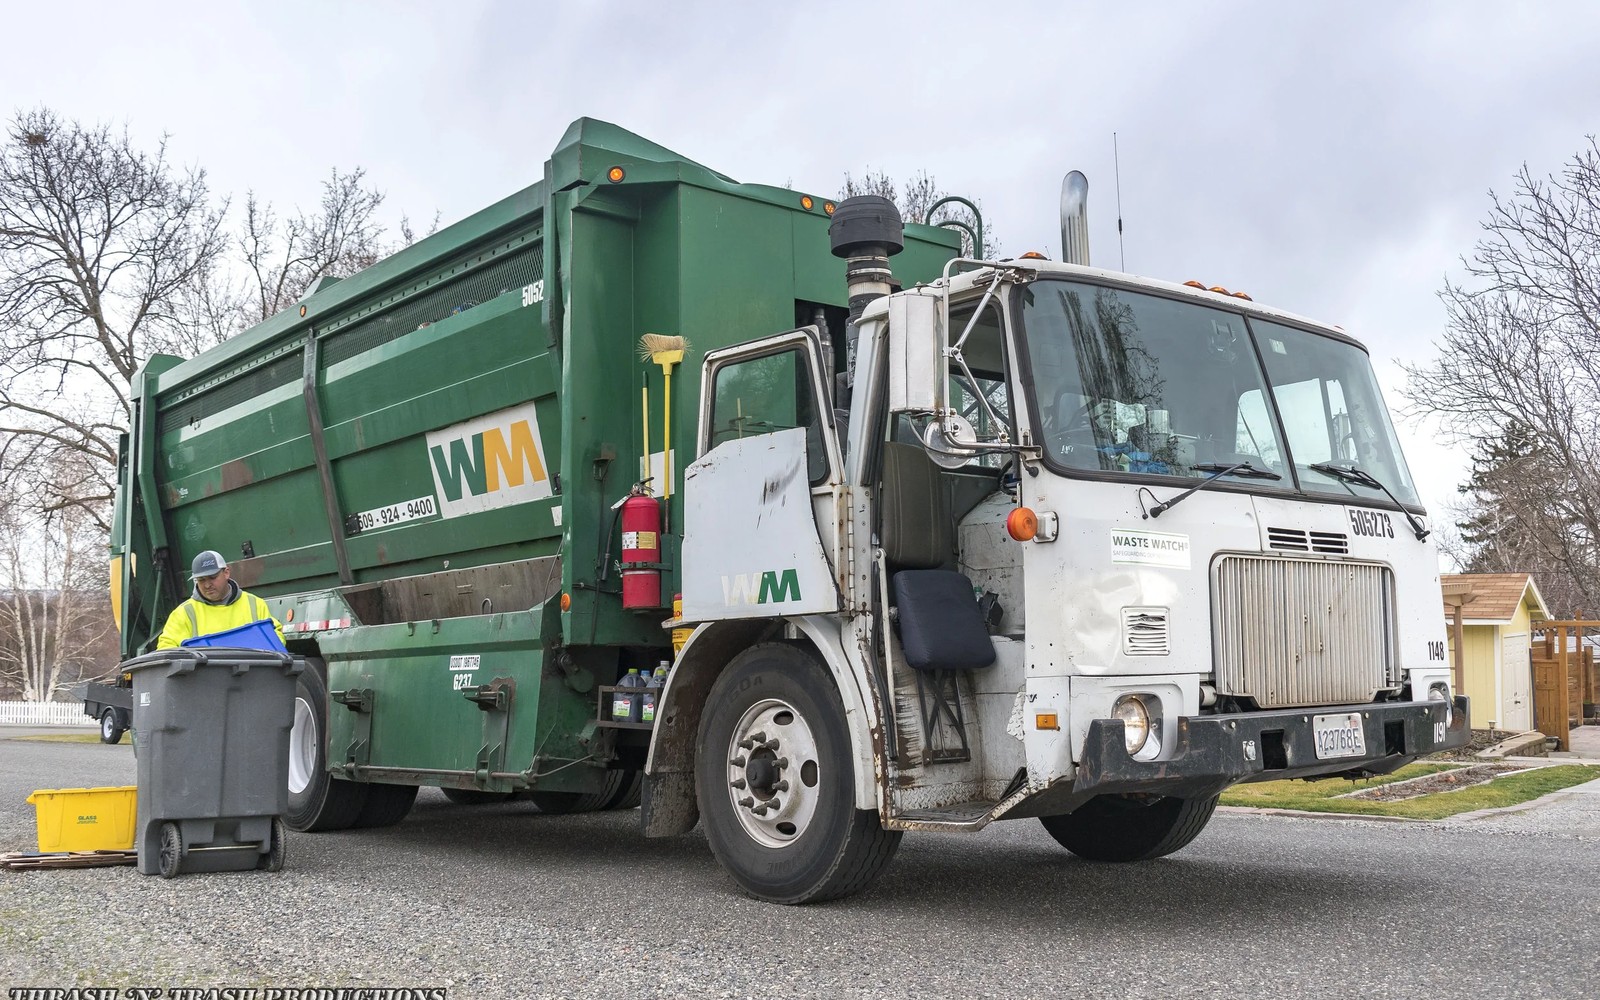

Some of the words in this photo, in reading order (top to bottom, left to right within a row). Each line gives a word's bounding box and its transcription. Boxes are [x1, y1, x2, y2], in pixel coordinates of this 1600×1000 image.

[430, 419, 547, 502] WM
[380, 507, 400, 525] 924
[407, 498, 433, 518] 9400
[1349, 509, 1395, 539] 505273
[1112, 535, 1149, 548] WASTE
[721, 568, 802, 607] WM
[1427, 641, 1445, 661] 1148
[1317, 727, 1362, 752] A23768E
